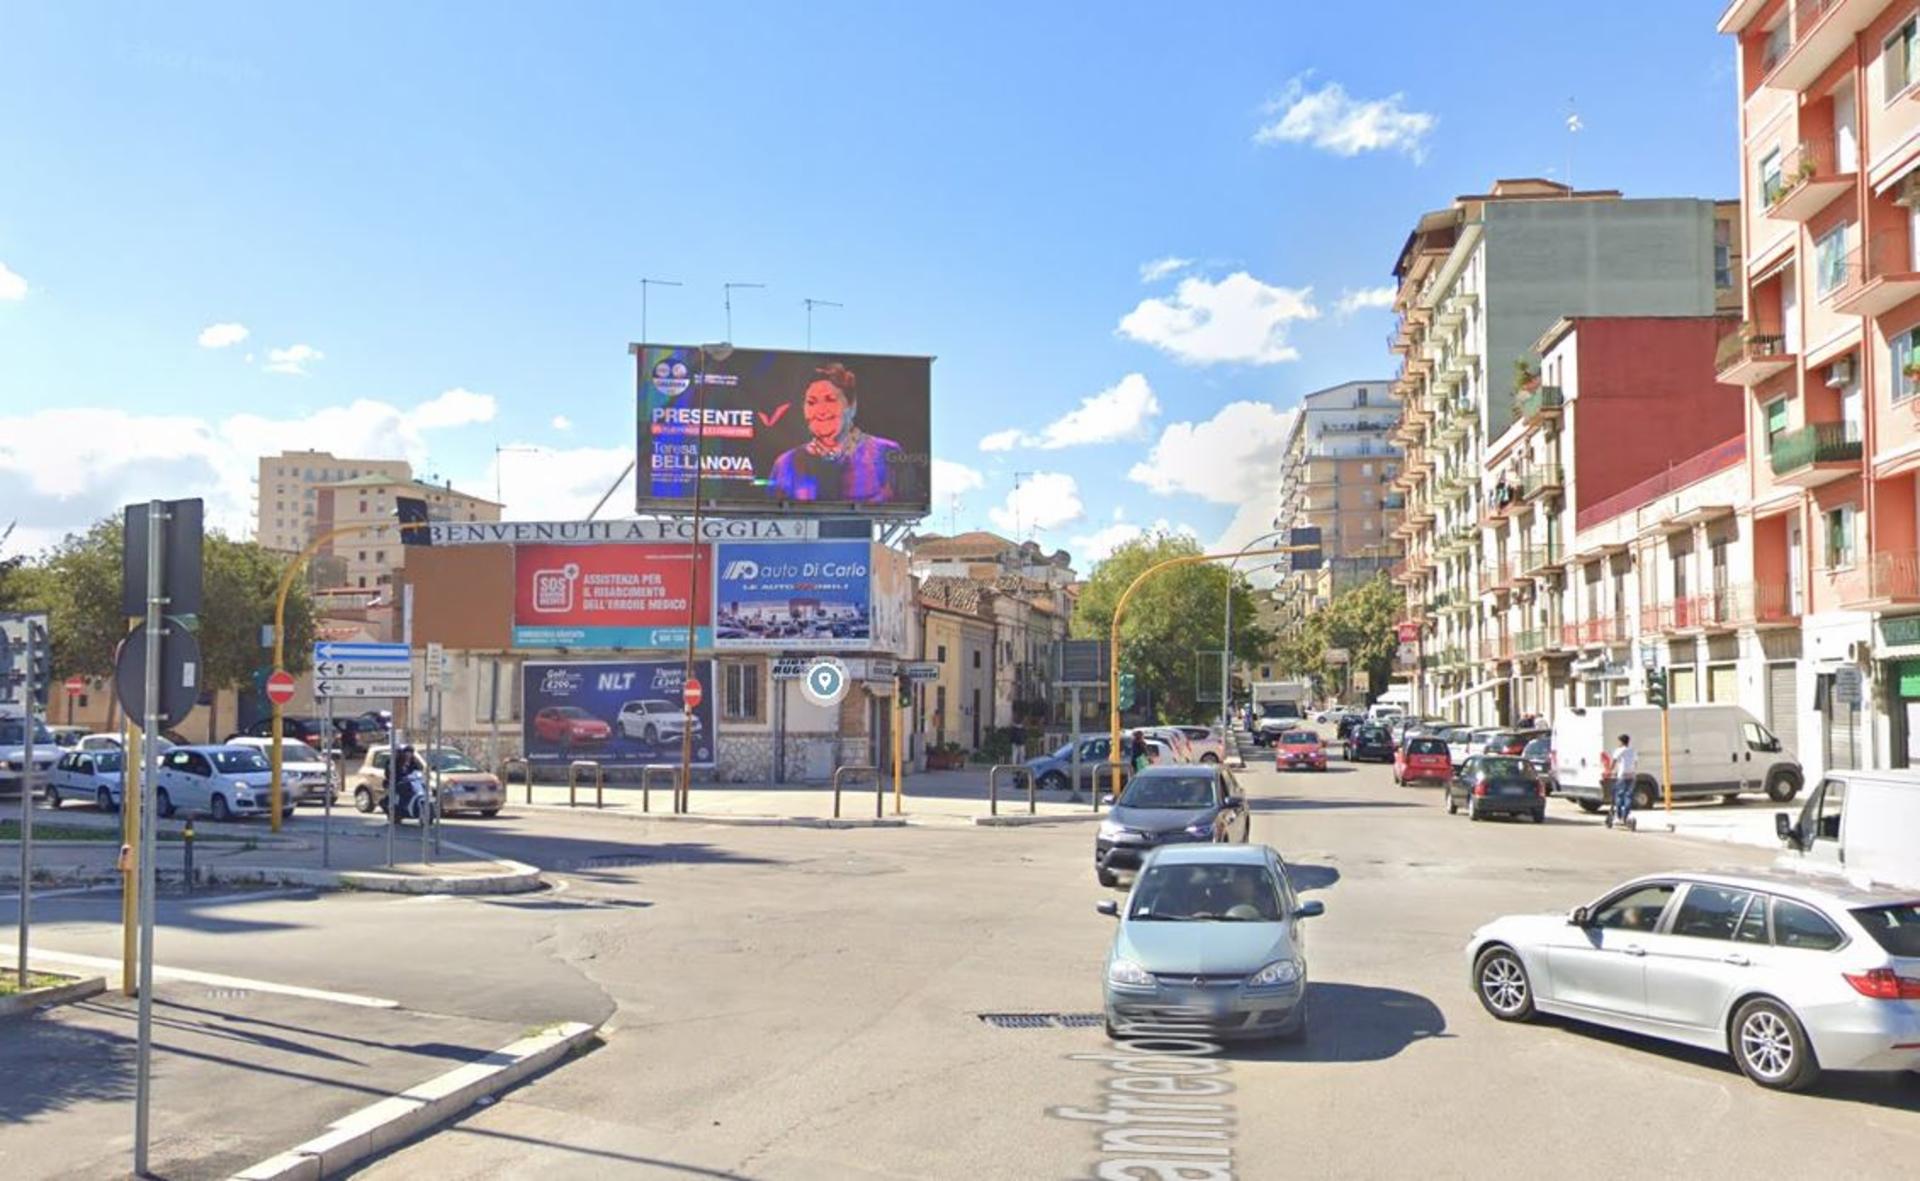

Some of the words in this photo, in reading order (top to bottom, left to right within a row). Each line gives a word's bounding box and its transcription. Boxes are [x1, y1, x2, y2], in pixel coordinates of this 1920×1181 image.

[652, 408, 753, 426] PRESENTE
[653, 441, 697, 455] Teresa
[652, 455, 753, 470] BELLANOVA
[431, 523, 611, 541] BENVENUTI
[625, 522, 644, 538] A
[658, 521, 783, 538] FOGGIA
[761, 563, 798, 577] auto
[803, 563, 818, 577] Di
[822, 563, 866, 577] Carlo
[540, 577, 566, 592] SOS
[583, 574, 639, 585] ASSISTENZA
[642, 574, 661, 585] PER
[583, 586, 591, 597] IL
[594, 586, 666, 597] RISARCIMENTO
[583, 599, 645, 610] DELL'ERRORE
[648, 599, 687, 610] MEDICO
[598, 673, 636, 691] NLT
